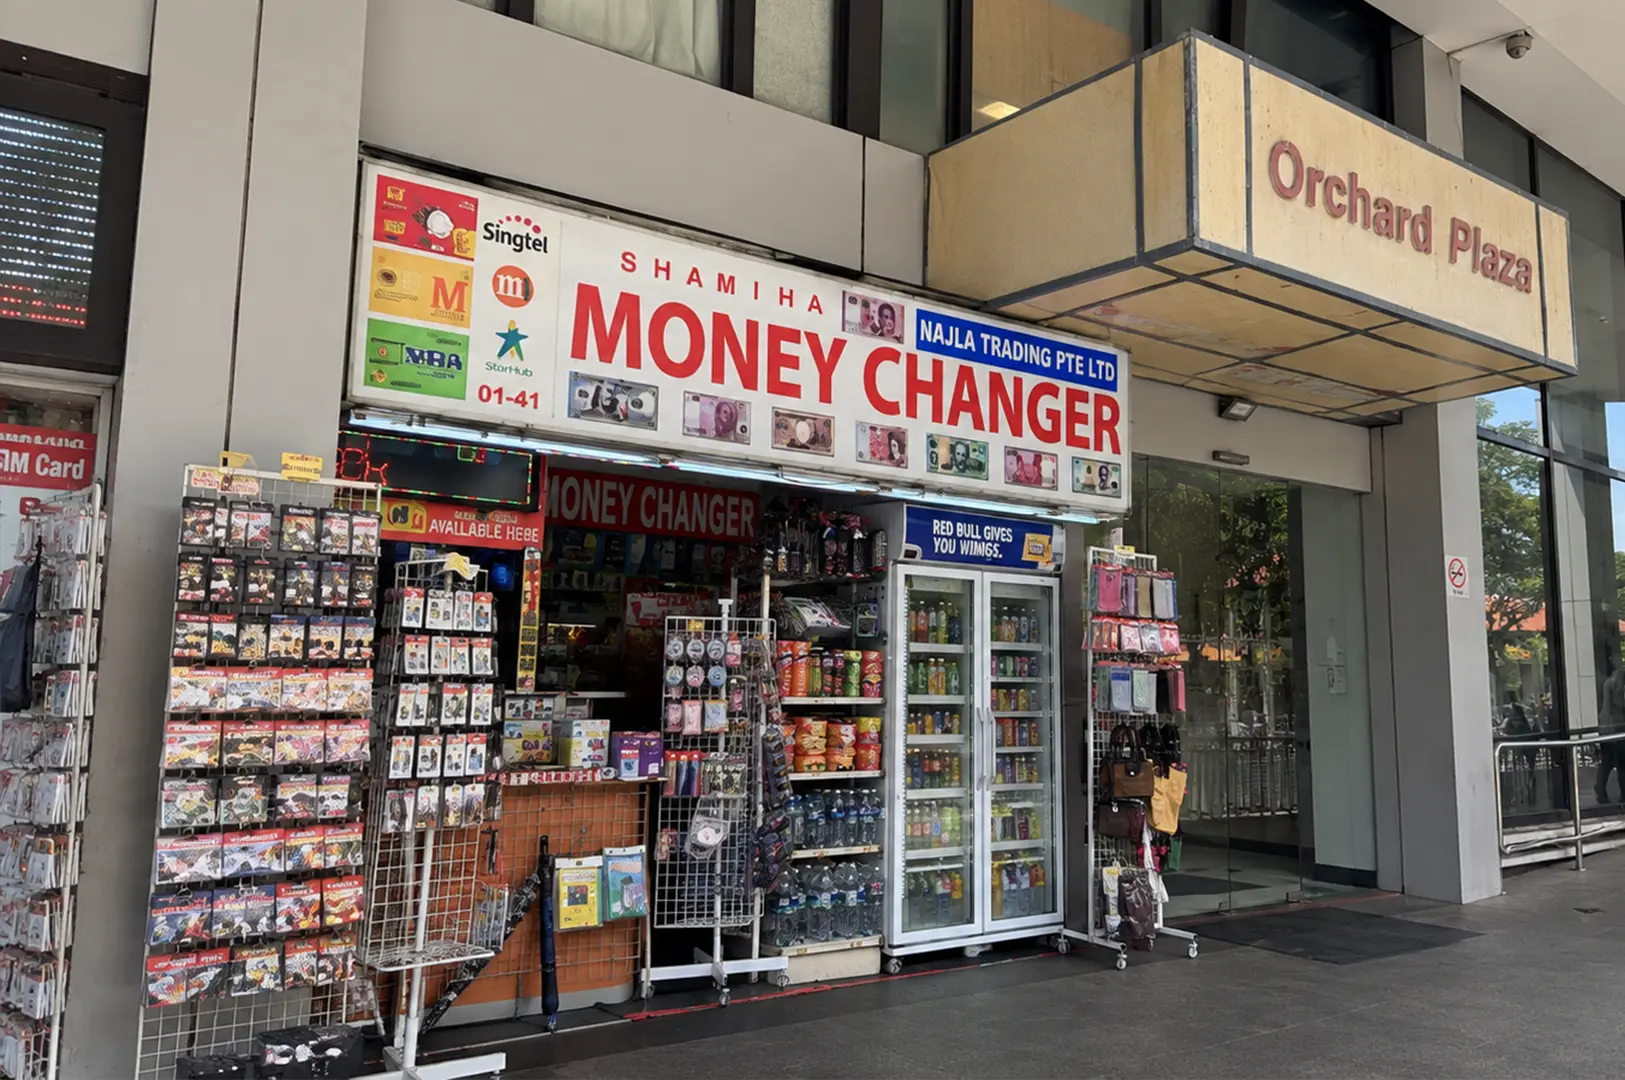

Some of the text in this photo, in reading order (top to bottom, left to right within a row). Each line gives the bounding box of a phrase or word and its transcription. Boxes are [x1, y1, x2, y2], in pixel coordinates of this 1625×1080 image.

[1269, 139, 1533, 294] Orchard Plaza
[482, 222, 549, 254] Singtel
[620, 250, 824, 315] SHAMIHA
[570, 282, 1121, 455] MONEY CHANGER
[920, 319, 1115, 382] NAJLA TRADING PTE LTD
[478, 384, 539, 410] 01-41
[35, 453, 85, 480] Card
[640, 487, 755, 538] CHANGER
[932, 519, 1013, 543] RED BULL GIVES
[933, 537, 956, 554] YOU
